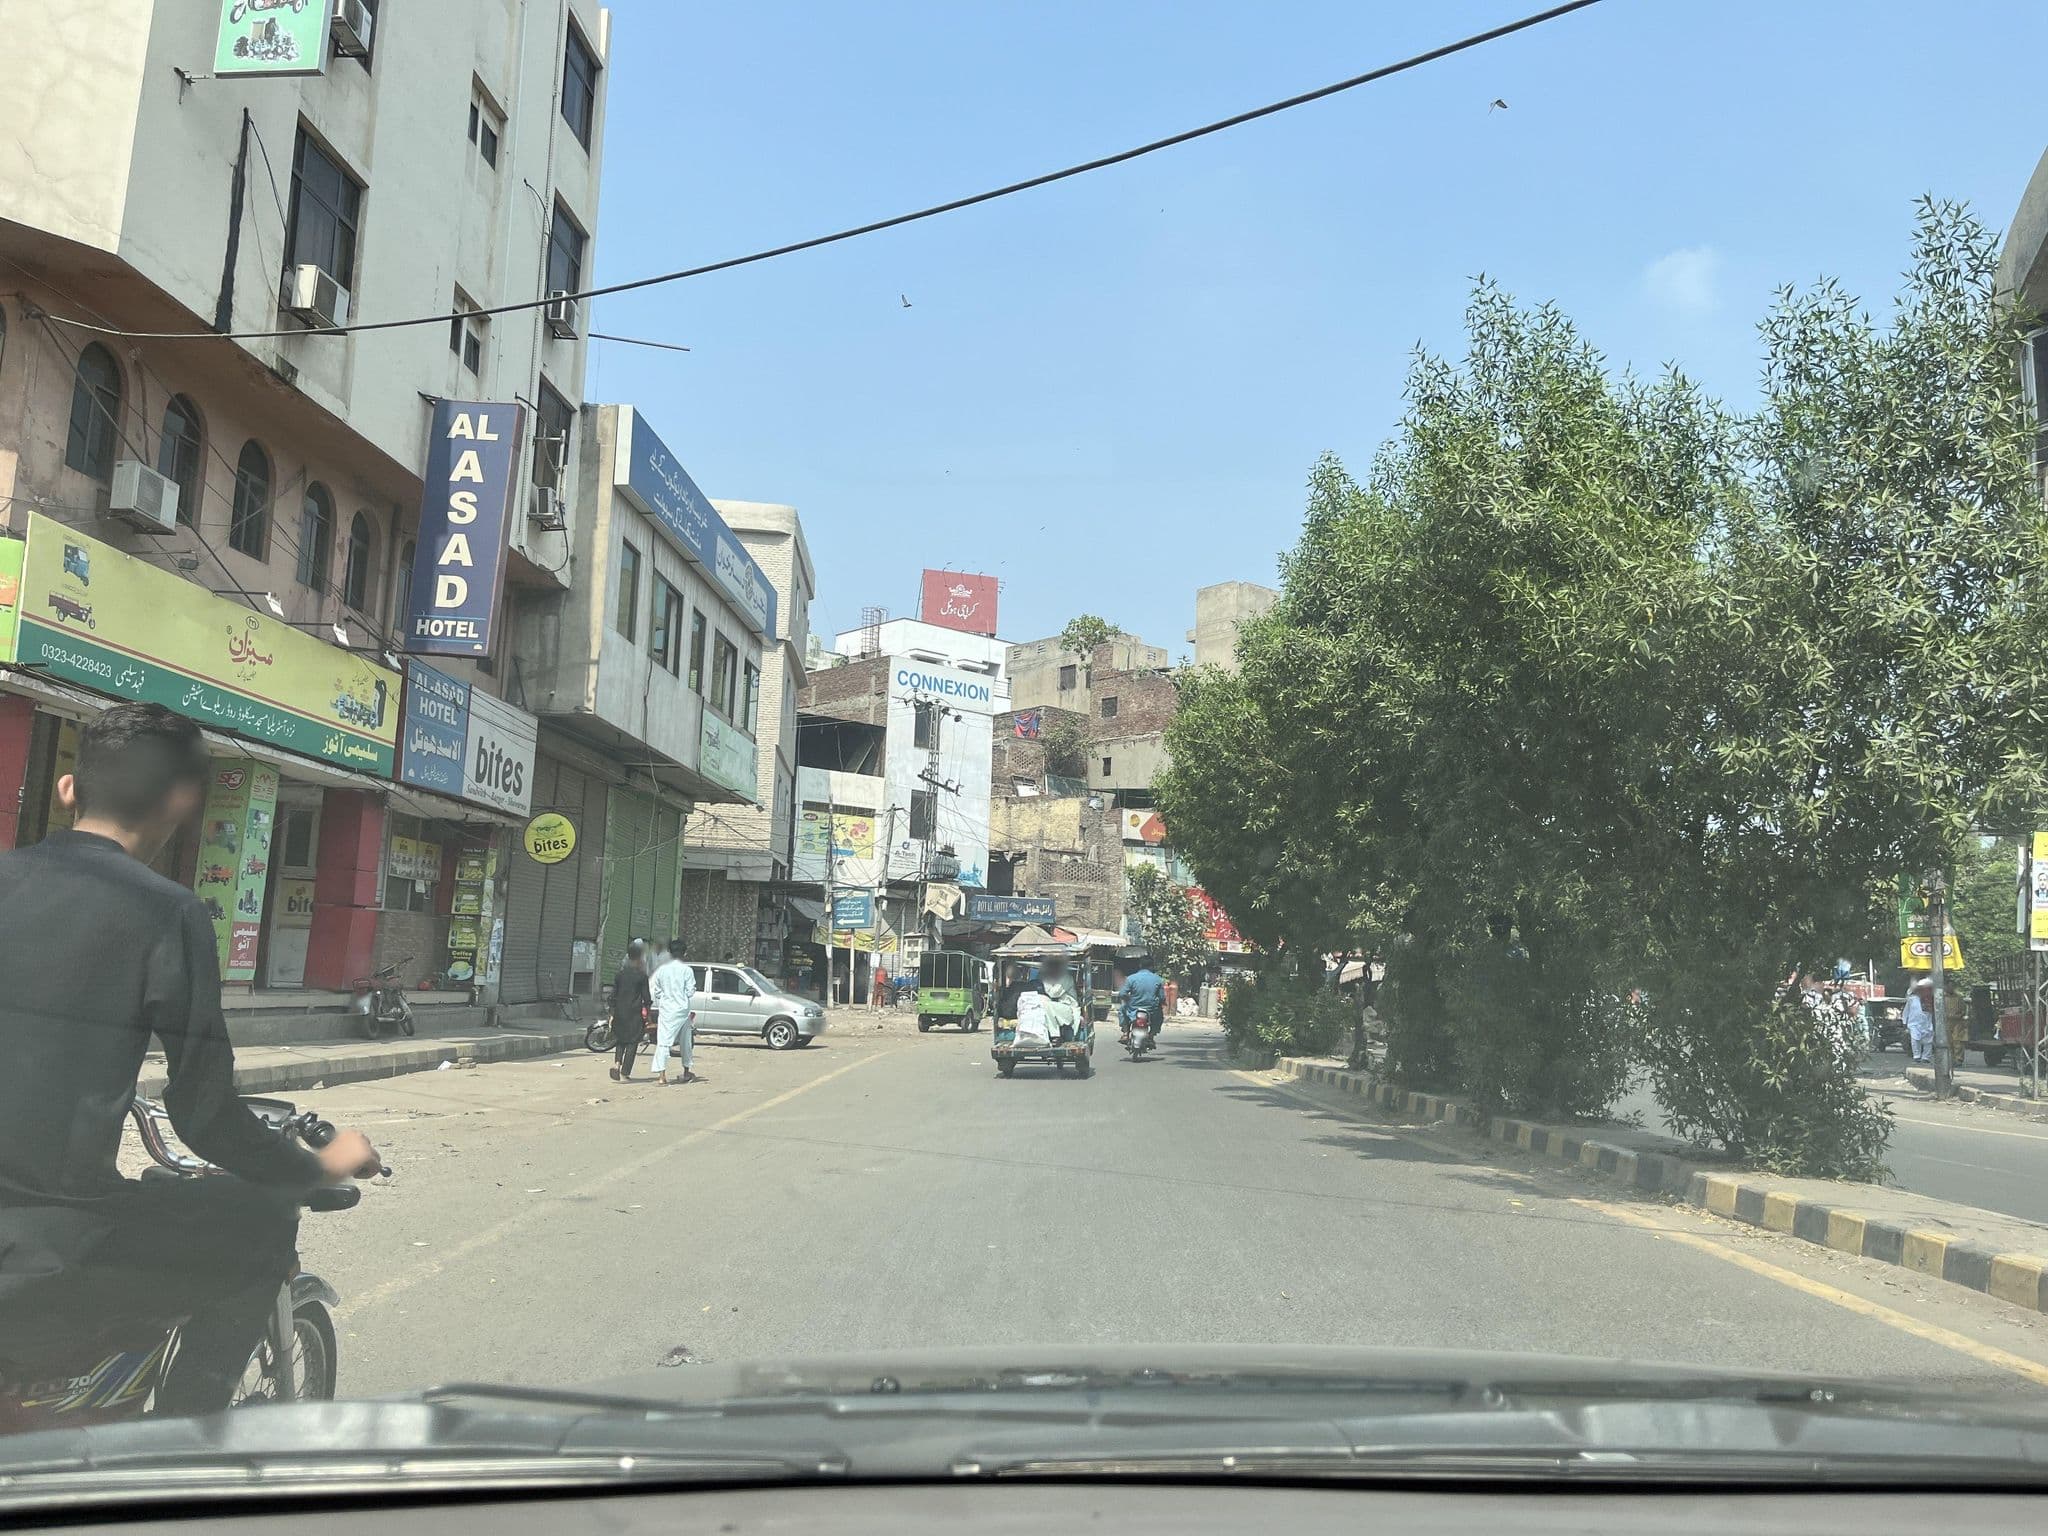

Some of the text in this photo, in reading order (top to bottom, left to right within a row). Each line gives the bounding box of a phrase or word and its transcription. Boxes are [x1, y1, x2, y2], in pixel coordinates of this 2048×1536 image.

[447, 413, 499, 441] AL
[415, 619, 479, 639] HOTEL
[41, 643, 112, 678] 0323-4228423
[897, 670, 990, 703] CONNEXION
[418, 696, 458, 726] HOTEL
[474, 736, 524, 797] bites
[534, 838, 568, 854] bites
